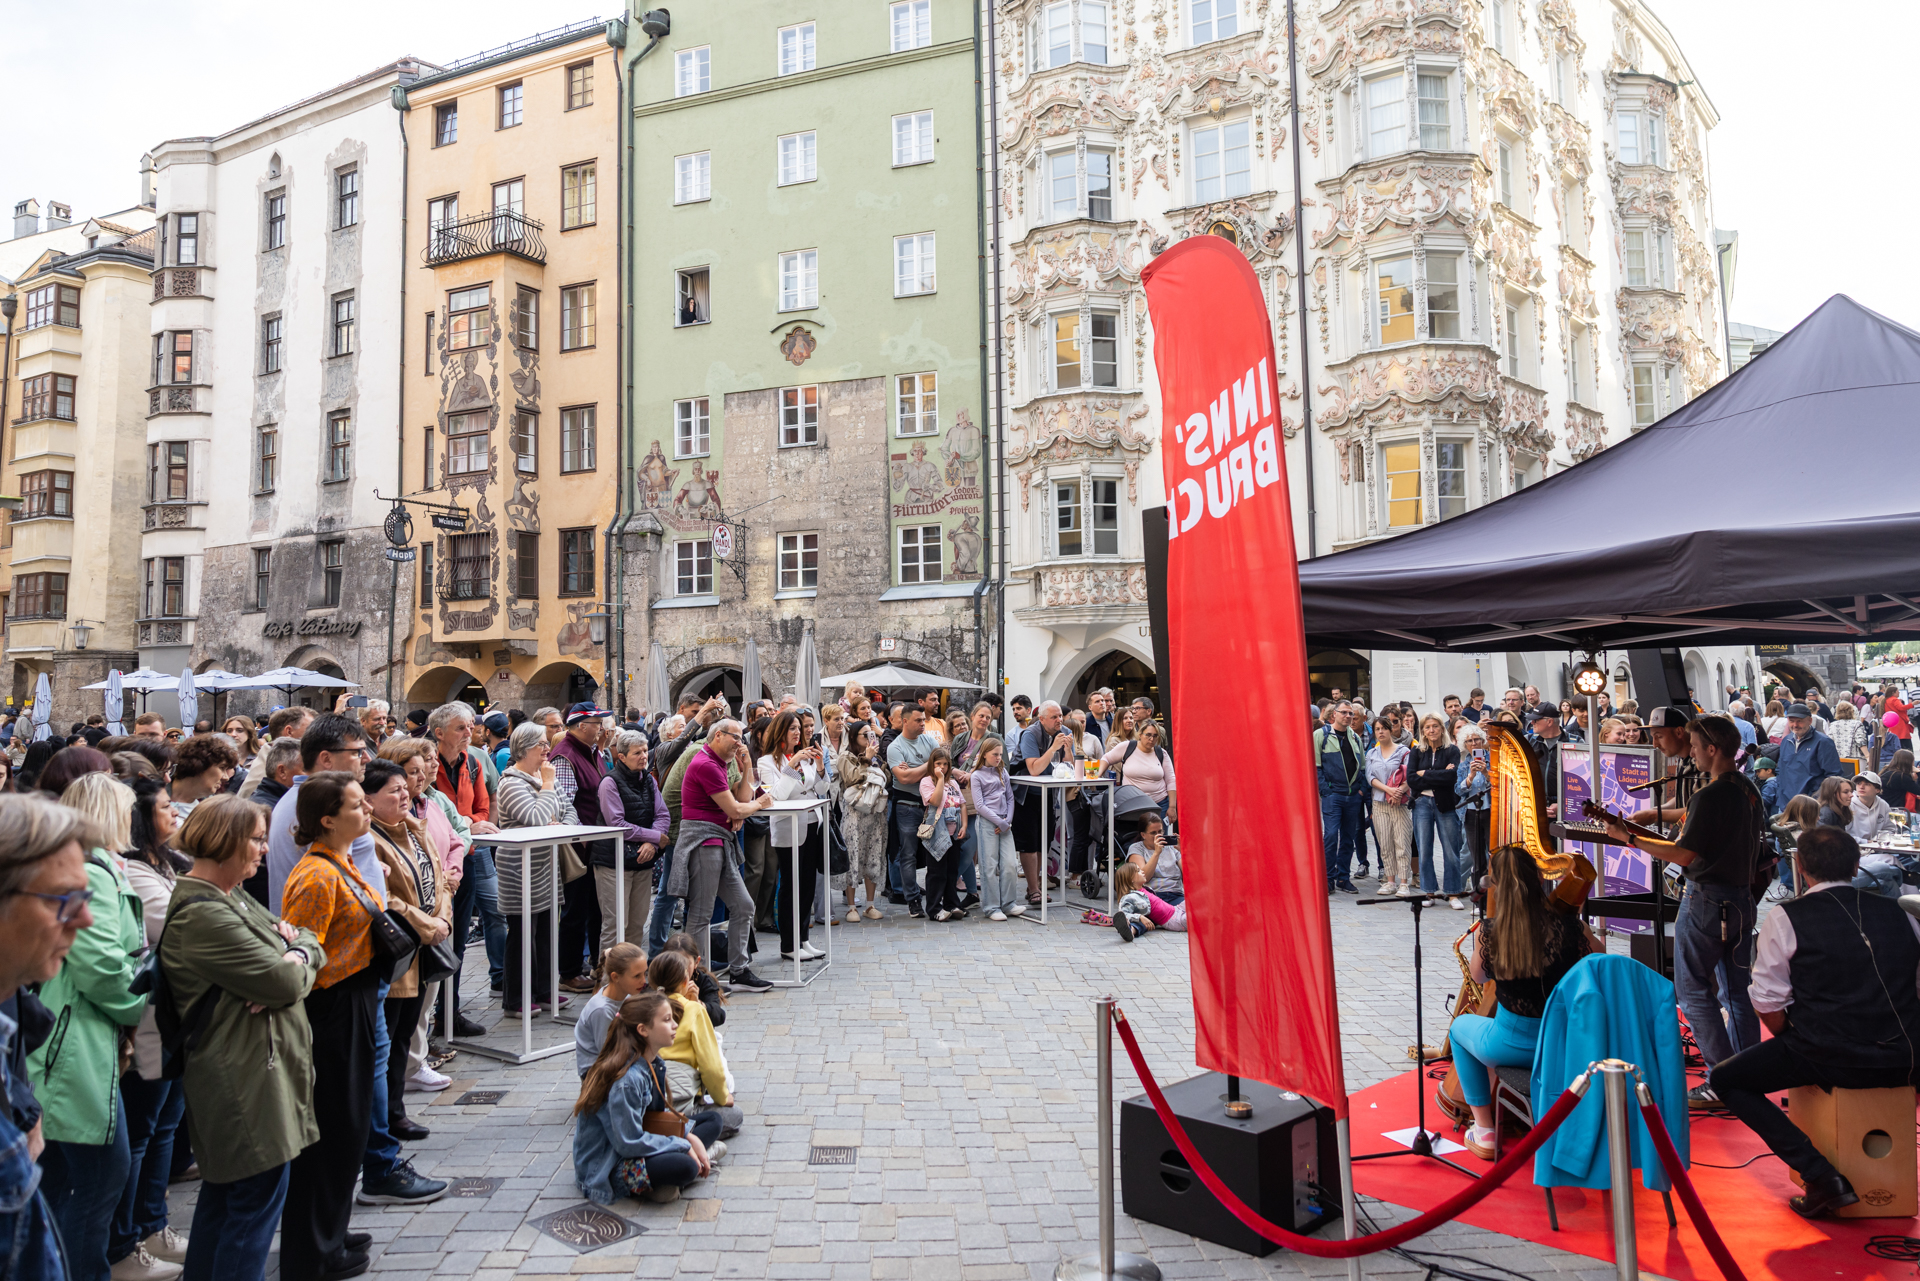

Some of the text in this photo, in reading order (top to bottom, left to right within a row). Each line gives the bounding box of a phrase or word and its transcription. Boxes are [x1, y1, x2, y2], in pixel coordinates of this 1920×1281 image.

[893, 491, 953, 517] Fürrutter
[438, 517, 464, 527] Weinhaus
[715, 536, 730, 549] HANDL
[392, 549, 414, 559] Happ
[262, 619, 361, 639] Café Katzung
[697, 636, 737, 644] Speckstube
[884, 639, 892, 648] 12
[1622, 767, 1639, 776] Stadt
[1567, 776, 1579, 784] Live
[1618, 775, 1637, 784] Läden
